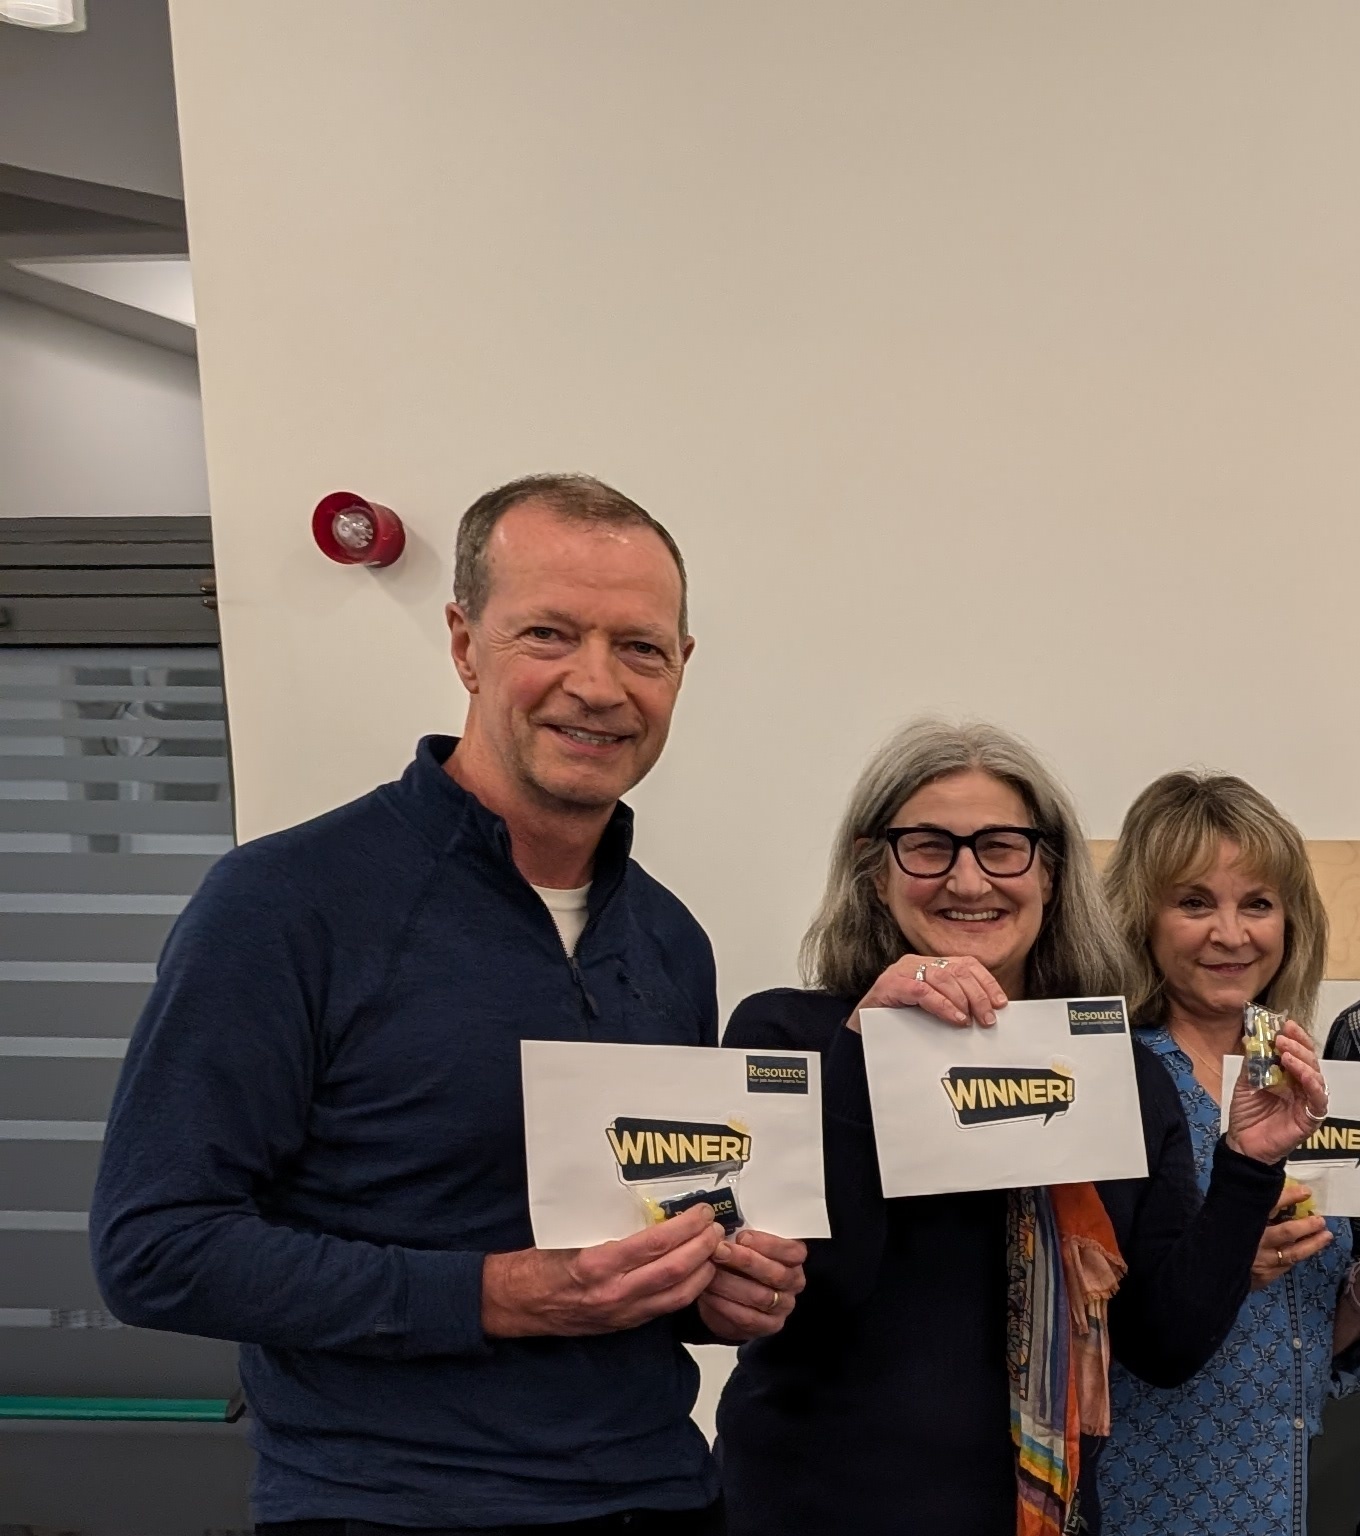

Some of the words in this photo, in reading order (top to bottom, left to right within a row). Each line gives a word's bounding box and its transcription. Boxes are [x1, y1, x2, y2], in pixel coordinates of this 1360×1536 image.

[1070, 1009, 1123, 1021] Resource
[748, 1064, 806, 1079] Resource
[943, 1078, 1075, 1111] WINNER!
[607, 1129, 750, 1167] WINNER!
